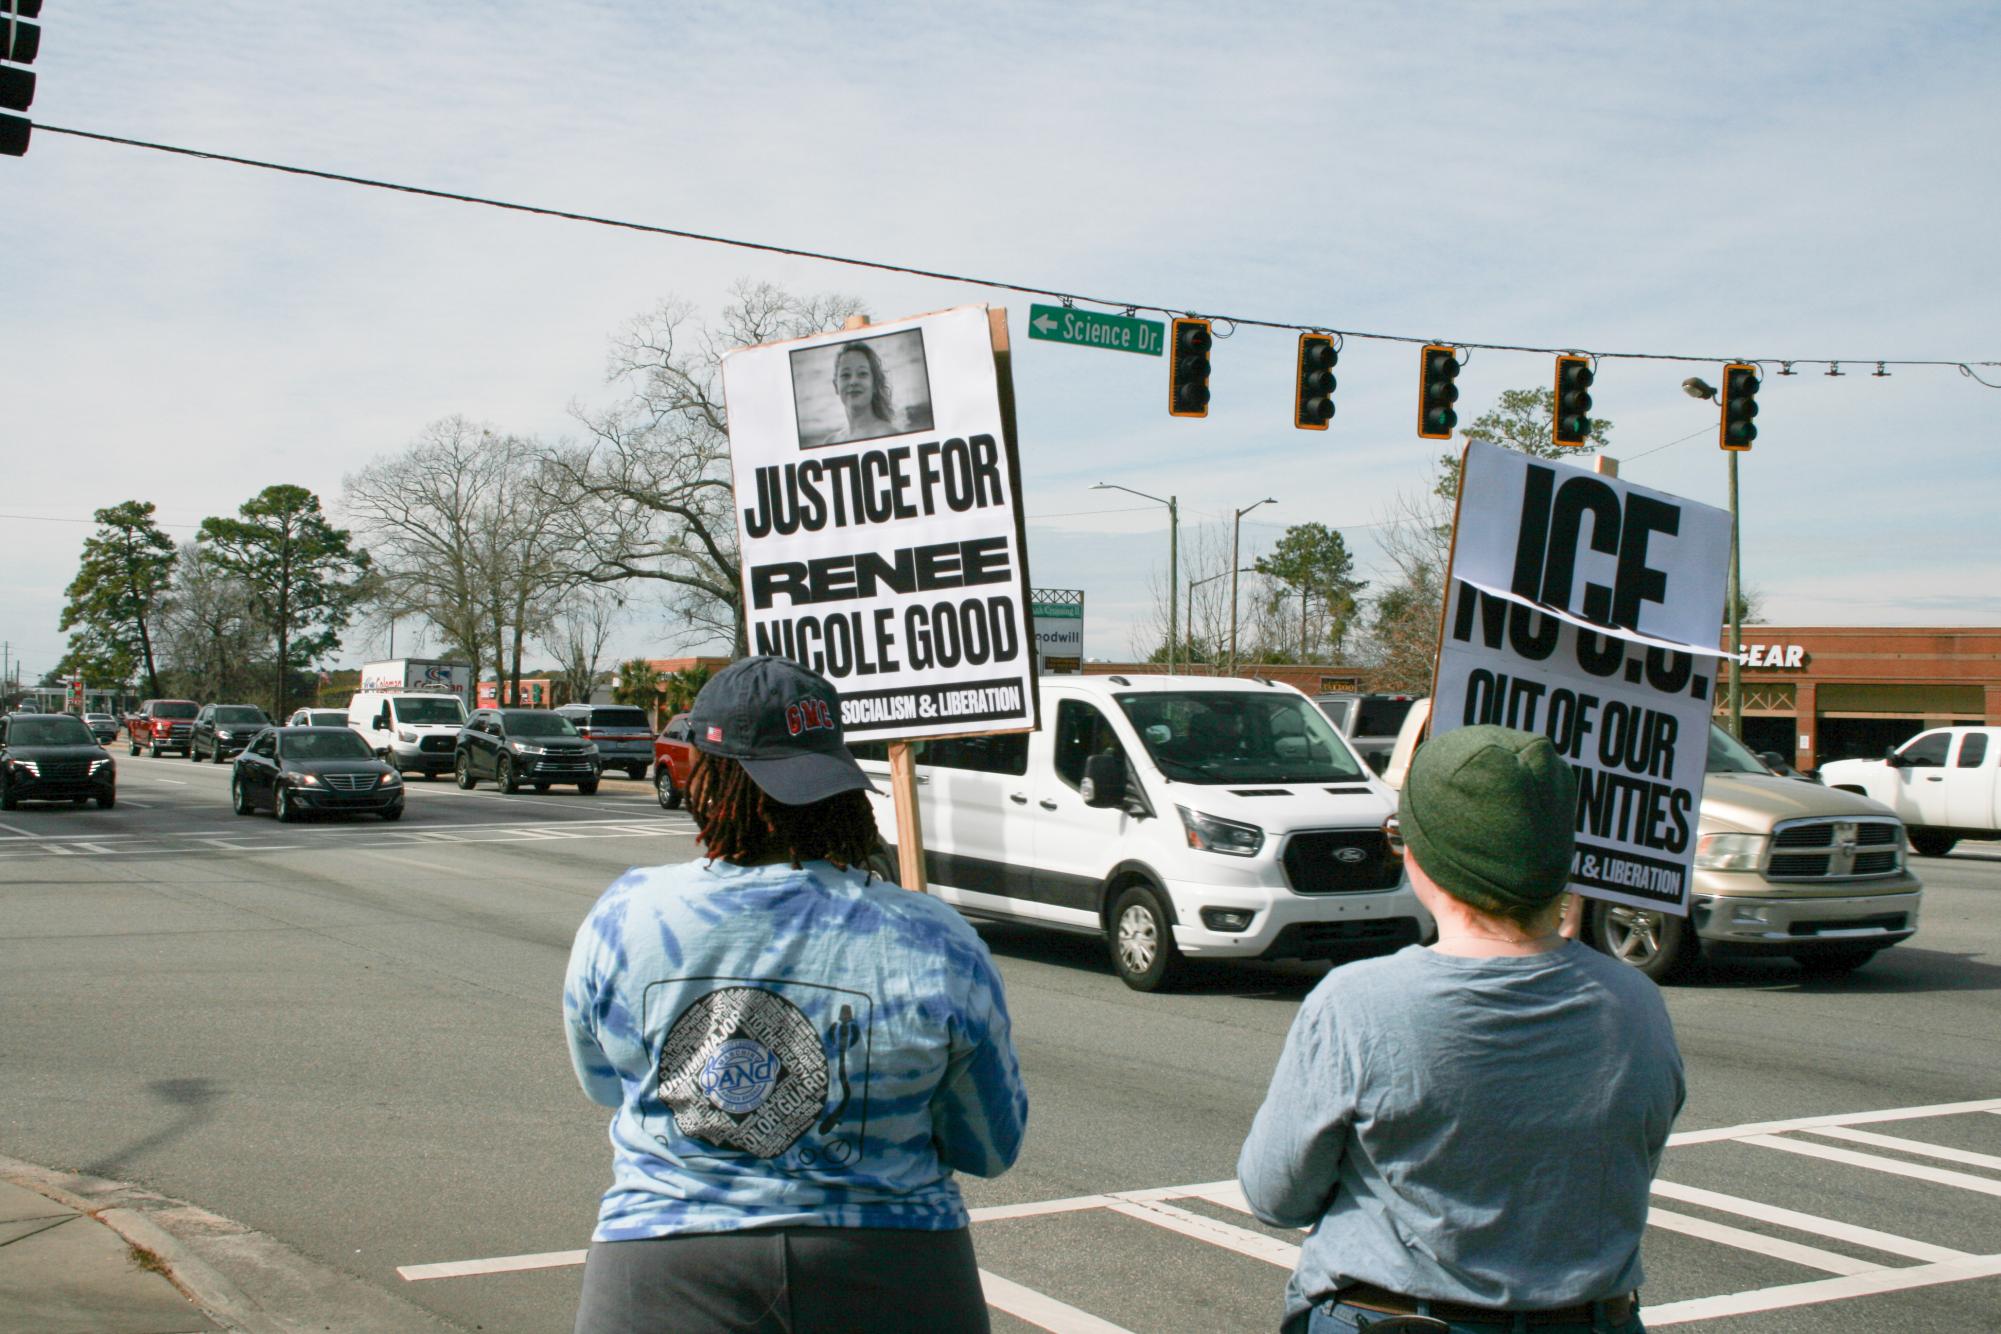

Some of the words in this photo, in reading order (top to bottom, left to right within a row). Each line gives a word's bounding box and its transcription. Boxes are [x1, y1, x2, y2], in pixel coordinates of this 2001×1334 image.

[1063, 313, 1130, 347] Science
[1138, 324, 1161, 352] Dr.
[744, 446, 918, 539] JUSTICE
[917, 433, 1005, 516] FOR
[750, 535, 1012, 610] RENEE
[1511, 463, 1690, 646] ICE
[755, 607, 900, 679] NICOLE
[904, 595, 1019, 671] GOOD
[1035, 631, 1079, 643] oodwill
[785, 700, 835, 737] GMC
[840, 694, 916, 726] SOCIALISM
[919, 694, 938, 718] &
[939, 686, 1021, 716] LIBERATION
[1463, 668, 1546, 730] OUT
[1546, 688, 1599, 759] OF
[1599, 701, 1679, 780] OUR
[1572, 763, 1693, 854] NITIES
[1582, 855, 1600, 879] &
[1602, 857, 1682, 896] LIBERATION
[696, 999, 726, 1033] BRASS
[747, 1012, 765, 1031] TO
[759, 1026, 781, 1050] THE
[776, 1045, 810, 1082] READY
[777, 1028, 817, 1073] TROMBONE
[658, 1053, 704, 1095] DRUM
[697, 1009, 745, 1059] MAJOR
[741, 1109, 781, 1149] OLOR
[775, 1067, 829, 1116] GUARD
[755, 1074, 801, 1116] MAJORETTE
